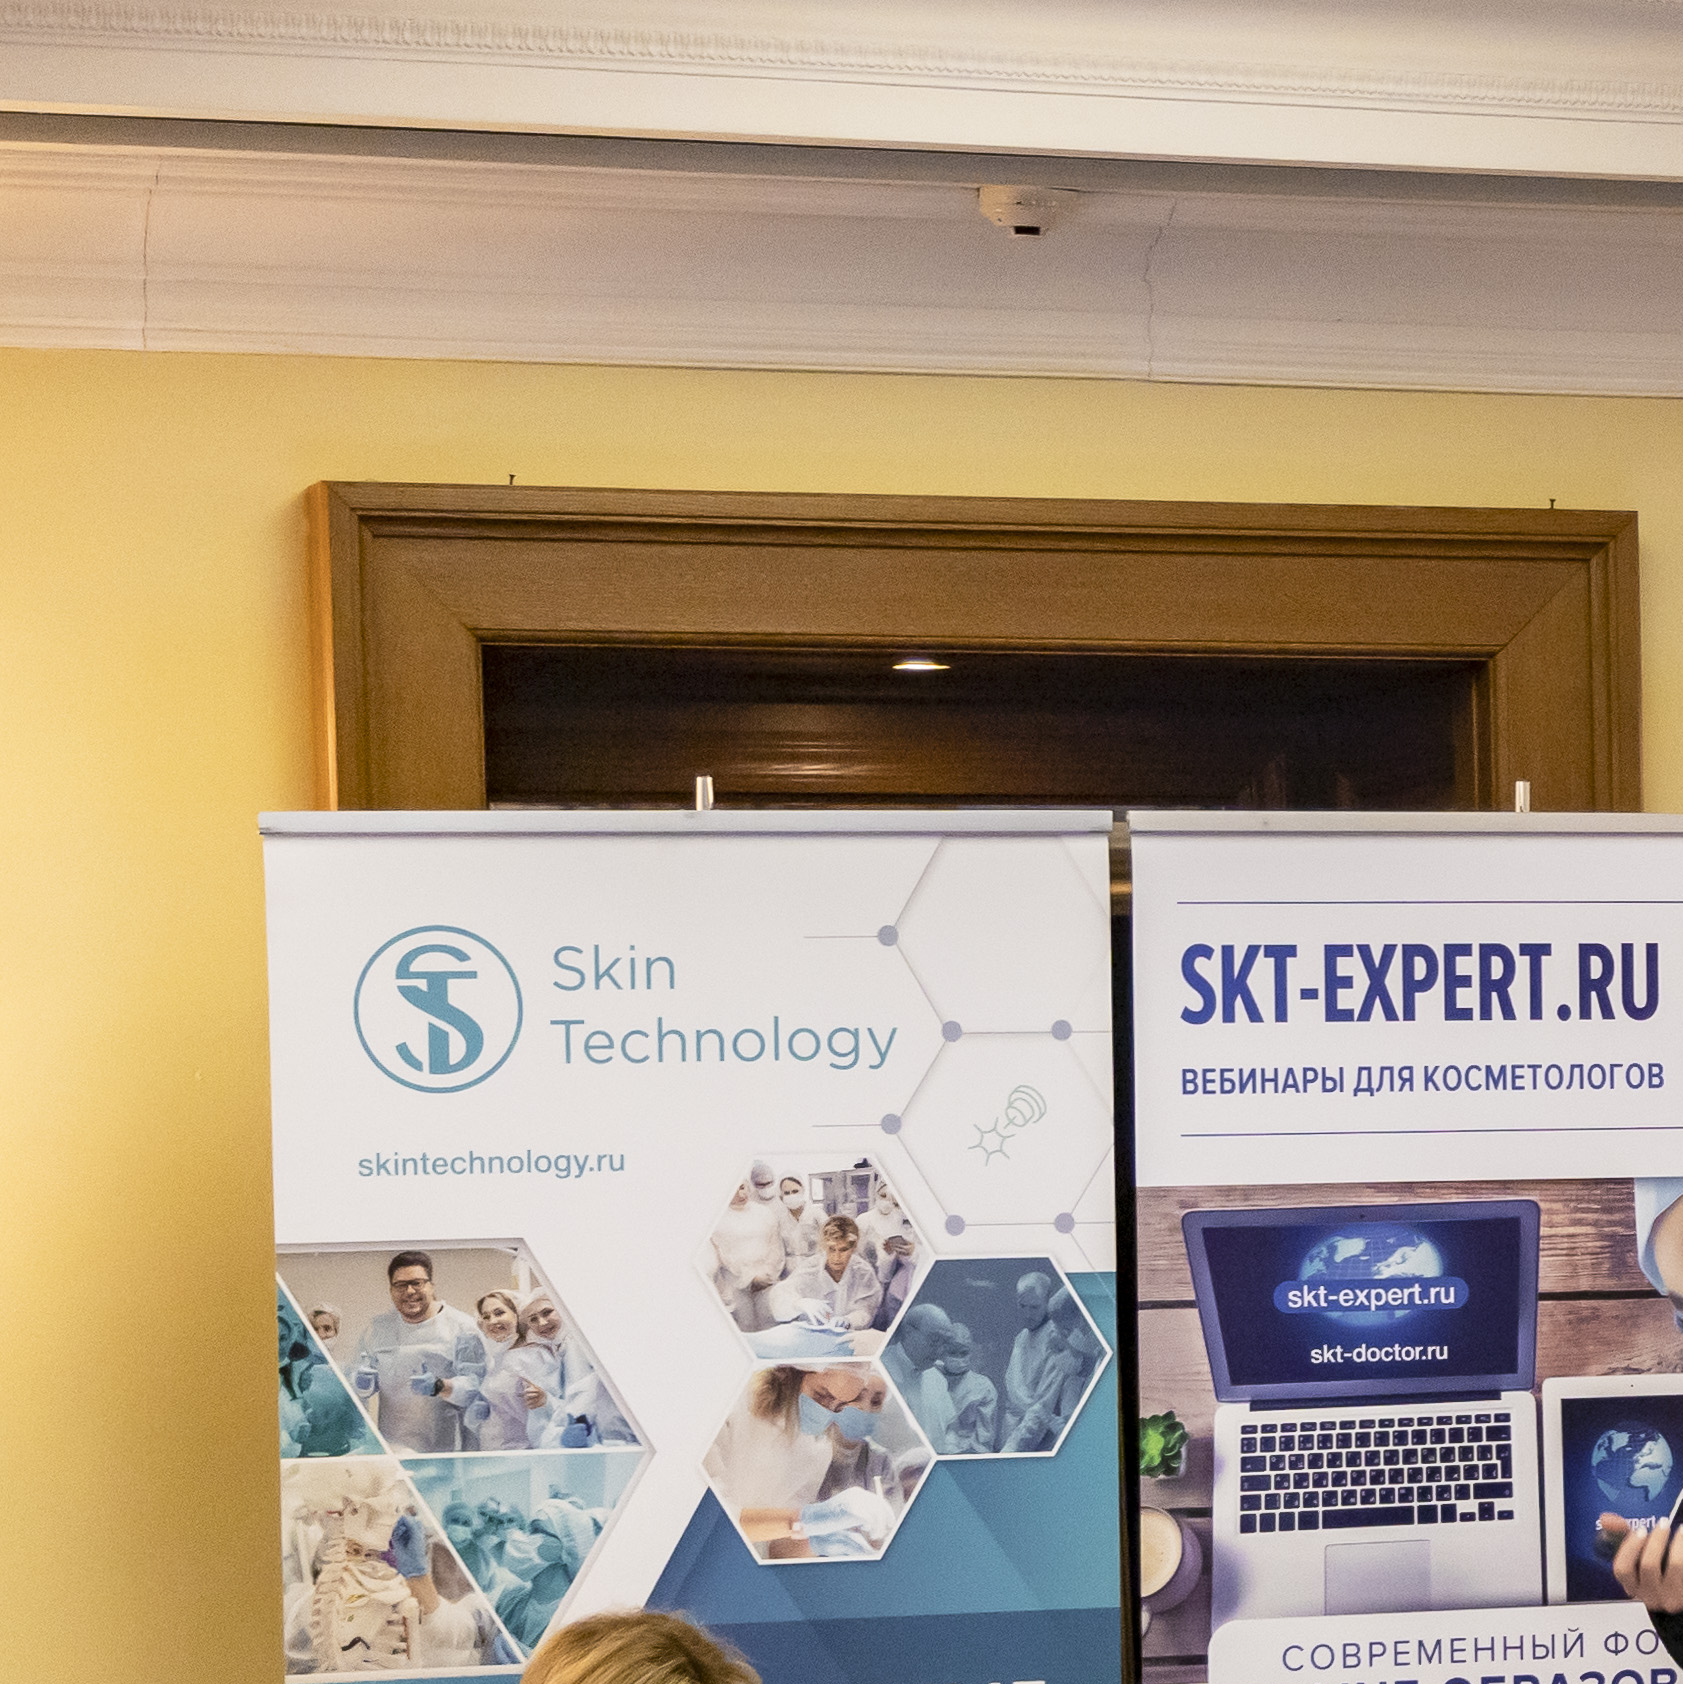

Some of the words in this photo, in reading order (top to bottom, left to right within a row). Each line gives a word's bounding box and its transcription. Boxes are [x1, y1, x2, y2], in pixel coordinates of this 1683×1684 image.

[552, 943, 676, 992] Skin
[1180, 941, 1660, 1026] SKT-EXPERT.RU
[549, 1015, 898, 1071] Technology
[1180, 1064, 1346, 1096] ВЕБИНАРЫ
[1352, 1066, 1415, 1099] ДЛЯ
[1422, 1061, 1666, 1092] КОСМЕТОЛОГОВ
[358, 1148, 625, 1180] skintechnology.ru
[1286, 1281, 1458, 1314] skt-expert.ru
[1310, 1341, 1449, 1365] skt-doctor.ru
[1281, 1625, 1586, 1672] СОВРЕМЕННЫЙ
